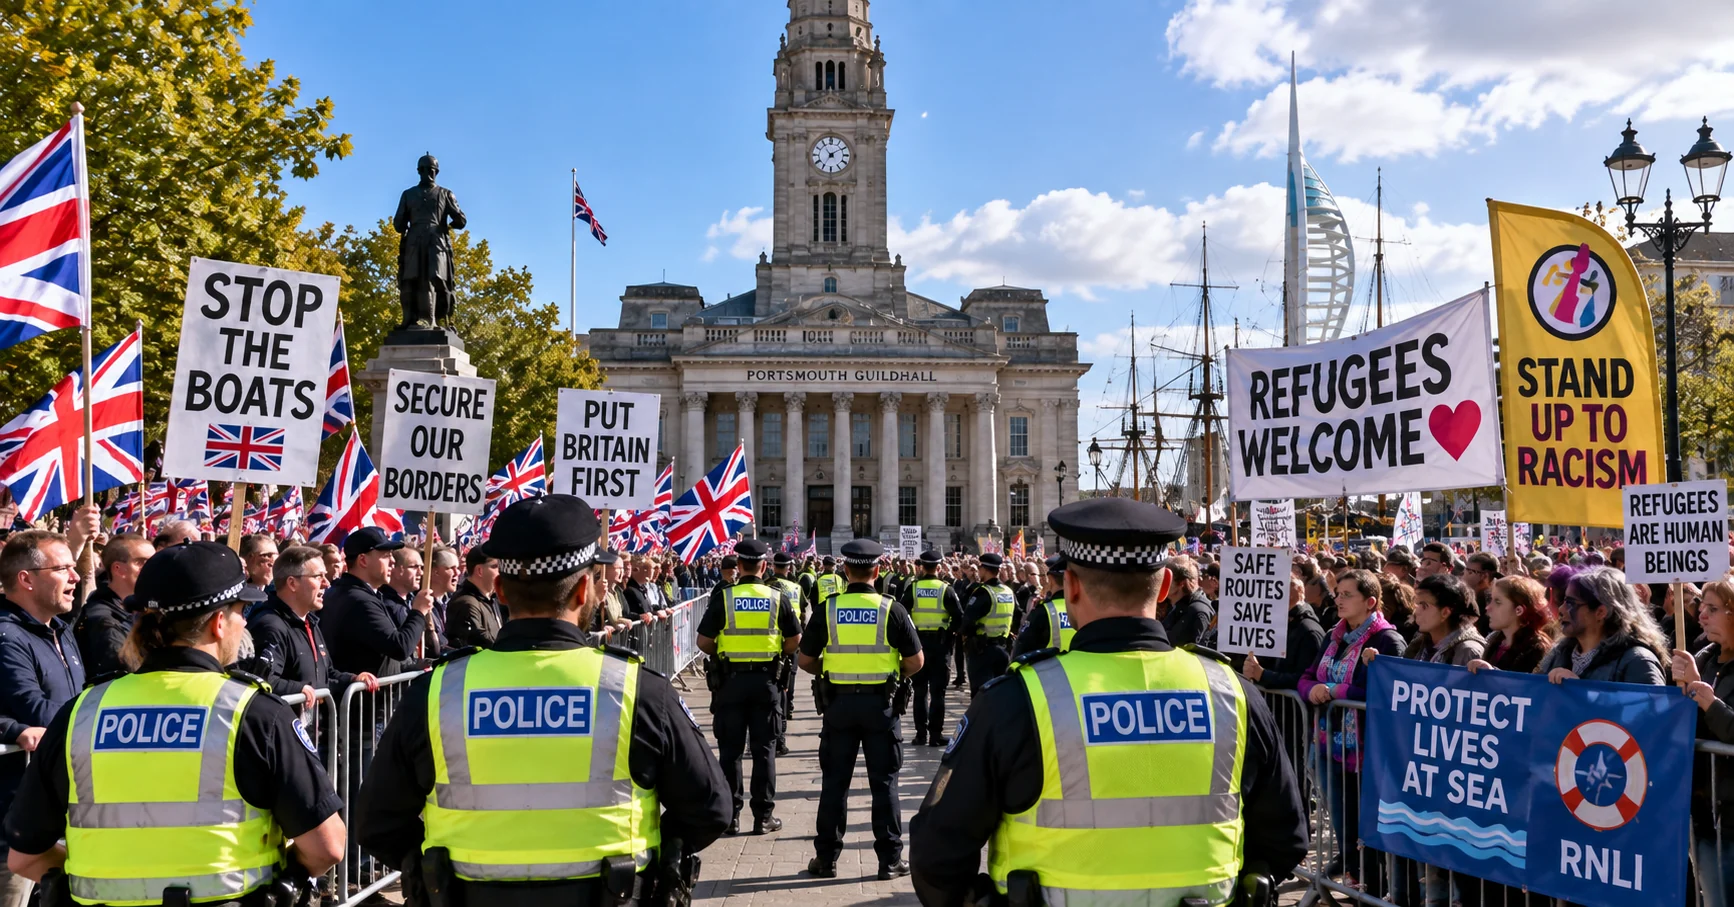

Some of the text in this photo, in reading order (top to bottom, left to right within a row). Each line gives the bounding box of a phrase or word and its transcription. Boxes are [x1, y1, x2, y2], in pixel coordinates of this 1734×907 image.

[201, 272, 324, 329] STOP
[219, 326, 293, 371] THE
[747, 369, 937, 382] PORTSMOUTH GUILDHALL
[1249, 332, 1452, 421] REFUGEES
[1517, 356, 1635, 399] STAND
[185, 369, 316, 421] BOATS
[394, 380, 488, 421] SECURE
[584, 399, 635, 430] PUT
[1531, 403, 1628, 443] UP TO
[410, 424, 465, 461] OUR
[562, 433, 651, 464] BRITAIN
[1237, 407, 1425, 478] WELCOME
[383, 467, 483, 505] BORDERS
[571, 467, 641, 497] FIRST
[1517, 446, 1647, 490] RACISM
[1629, 489, 1719, 517] REFUGEES
[1628, 519, 1724, 546] ARE HUMAN
[1233, 552, 1276, 575] SAFE
[1644, 549, 1709, 574] BEINGS
[735, 598, 769, 611] POLICE
[1224, 577, 1284, 601] ROUTES
[838, 609, 877, 623] POLICE
[1232, 601, 1273, 625] SAVE
[1228, 625, 1276, 650] LIVES
[474, 695, 586, 729] POLICE
[1089, 698, 1207, 736] POLICE
[1391, 679, 1532, 732] PROTECT
[99, 712, 201, 745] POLICE
[1413, 722, 1499, 770] LIVES
[1401, 760, 1508, 814] AT SEA
[1560, 839, 1643, 891] RNLI
